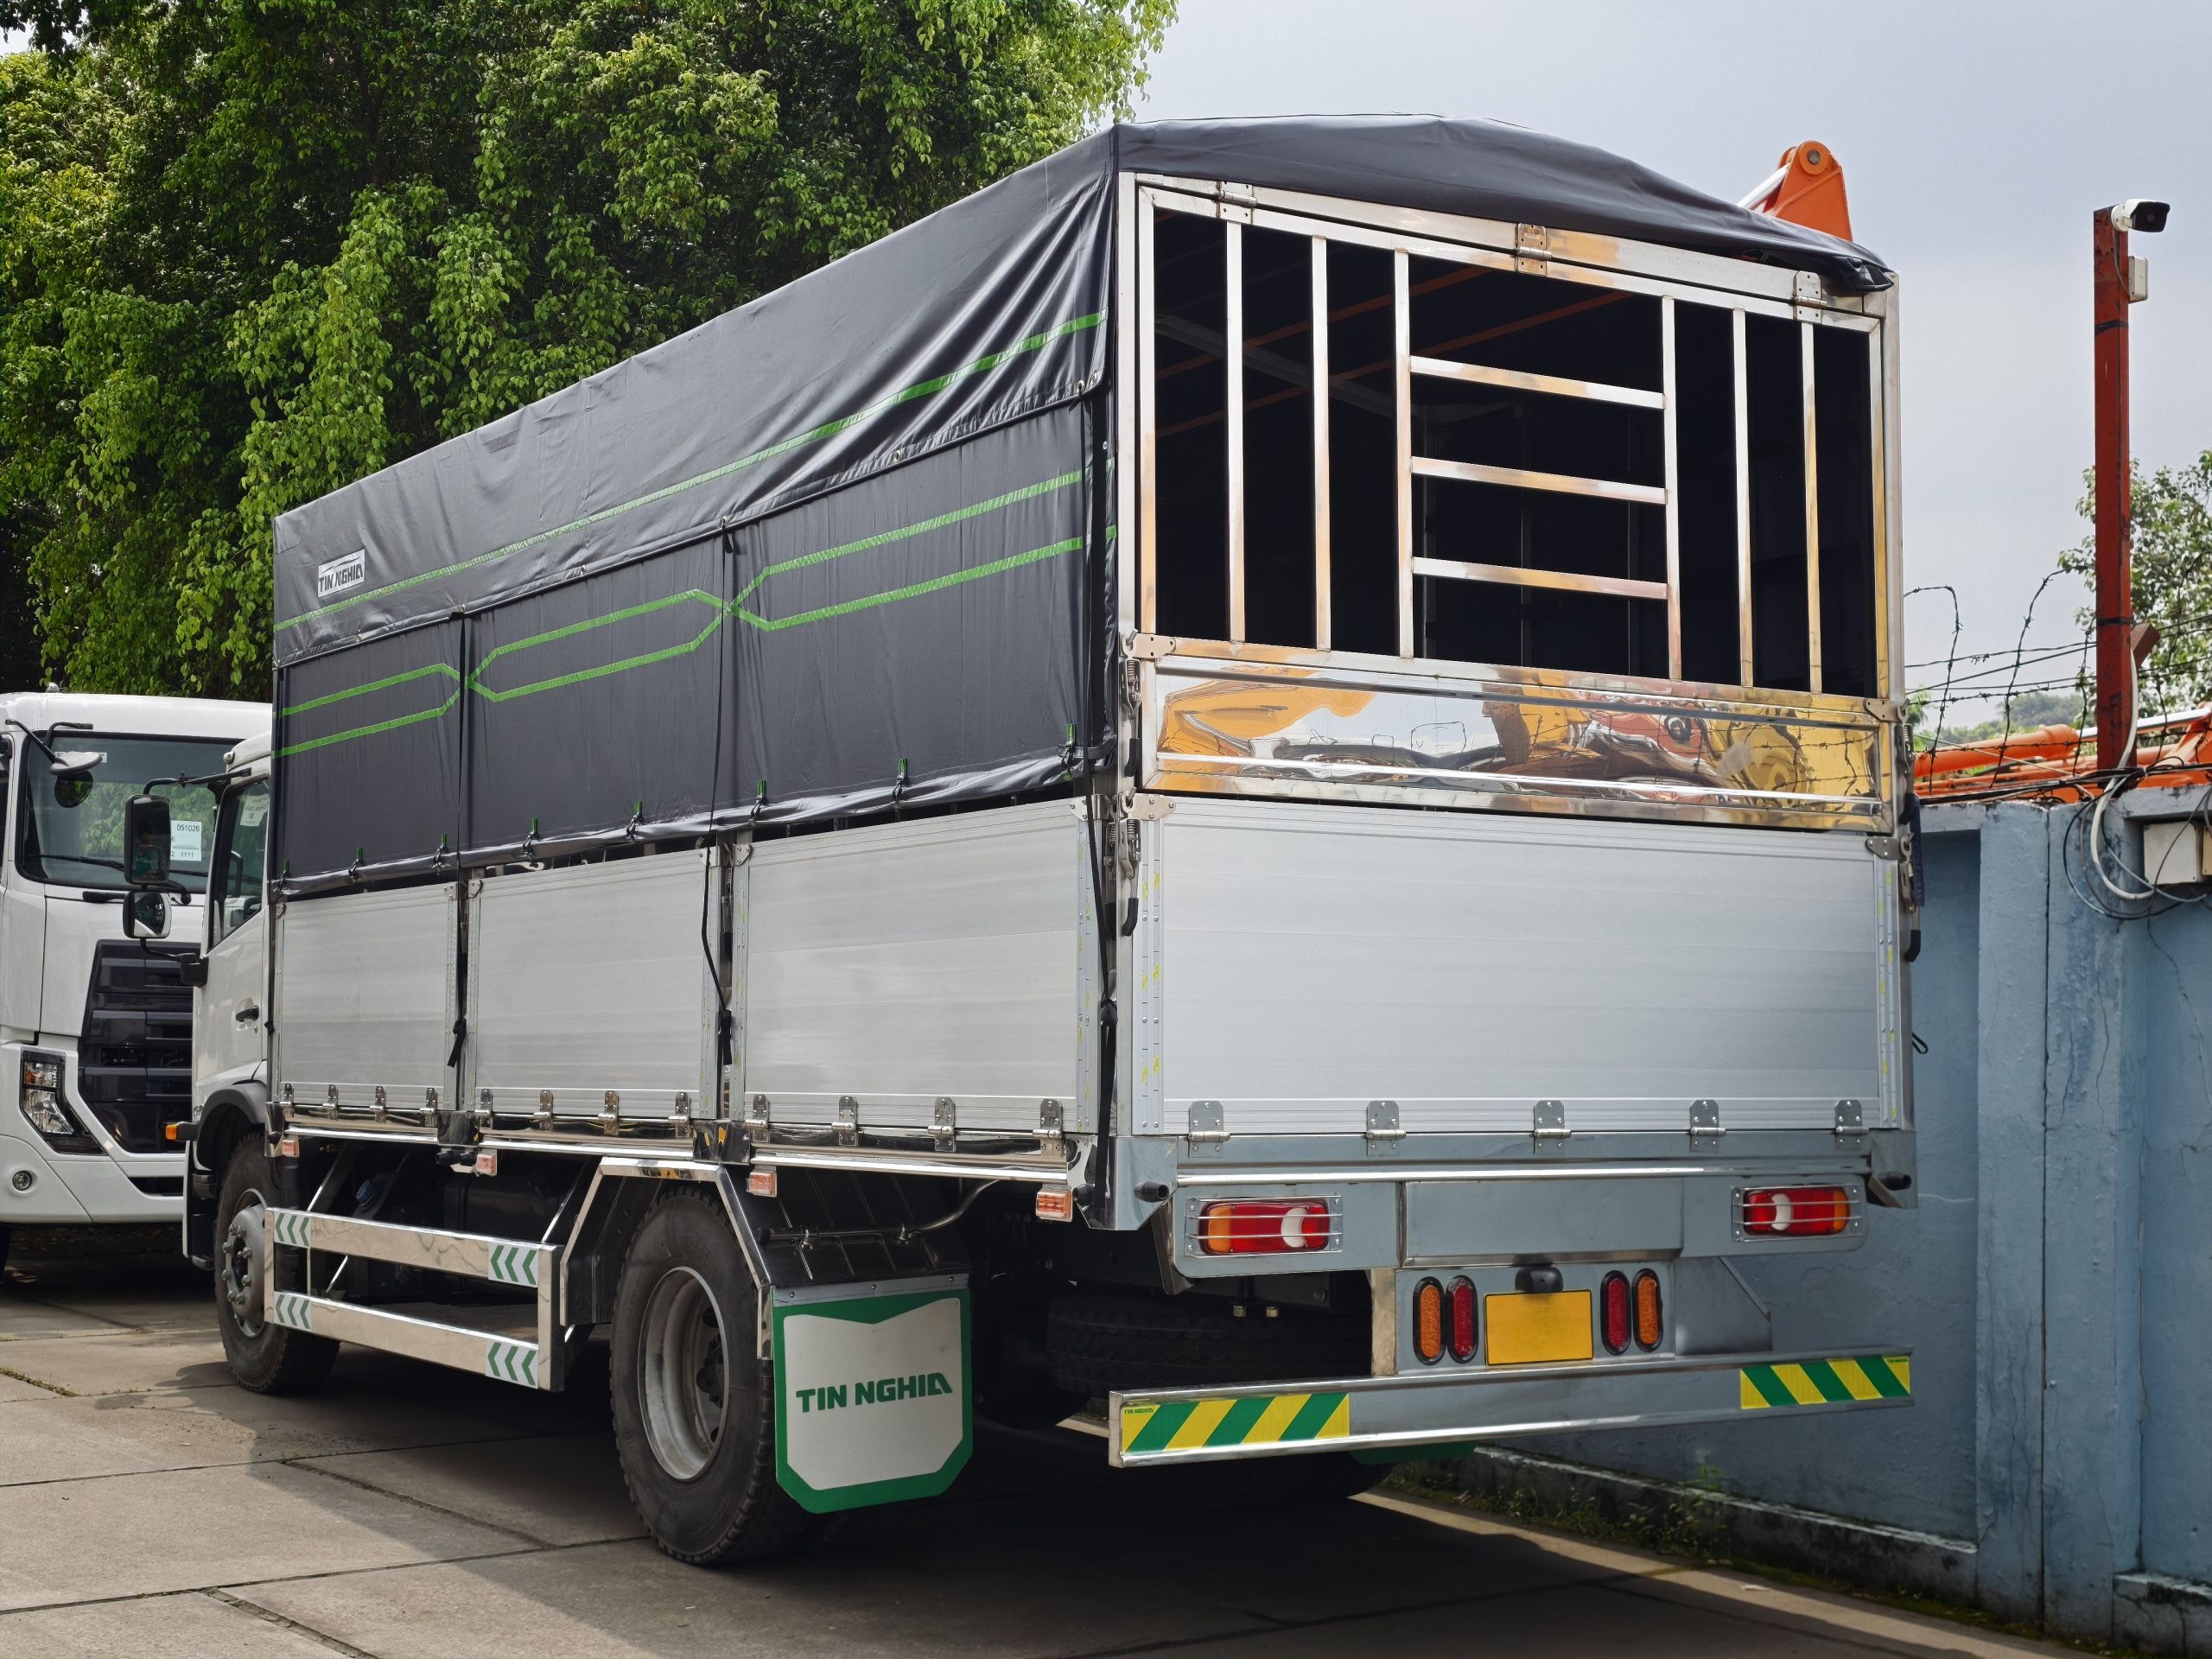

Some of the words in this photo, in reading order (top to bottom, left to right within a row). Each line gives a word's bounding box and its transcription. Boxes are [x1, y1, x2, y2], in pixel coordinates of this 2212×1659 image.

[319, 574, 334, 593] TIN
[334, 563, 363, 588] NGHIA
[796, 1384, 847, 1413] TIN
[855, 1372, 953, 1406] NGHIA
